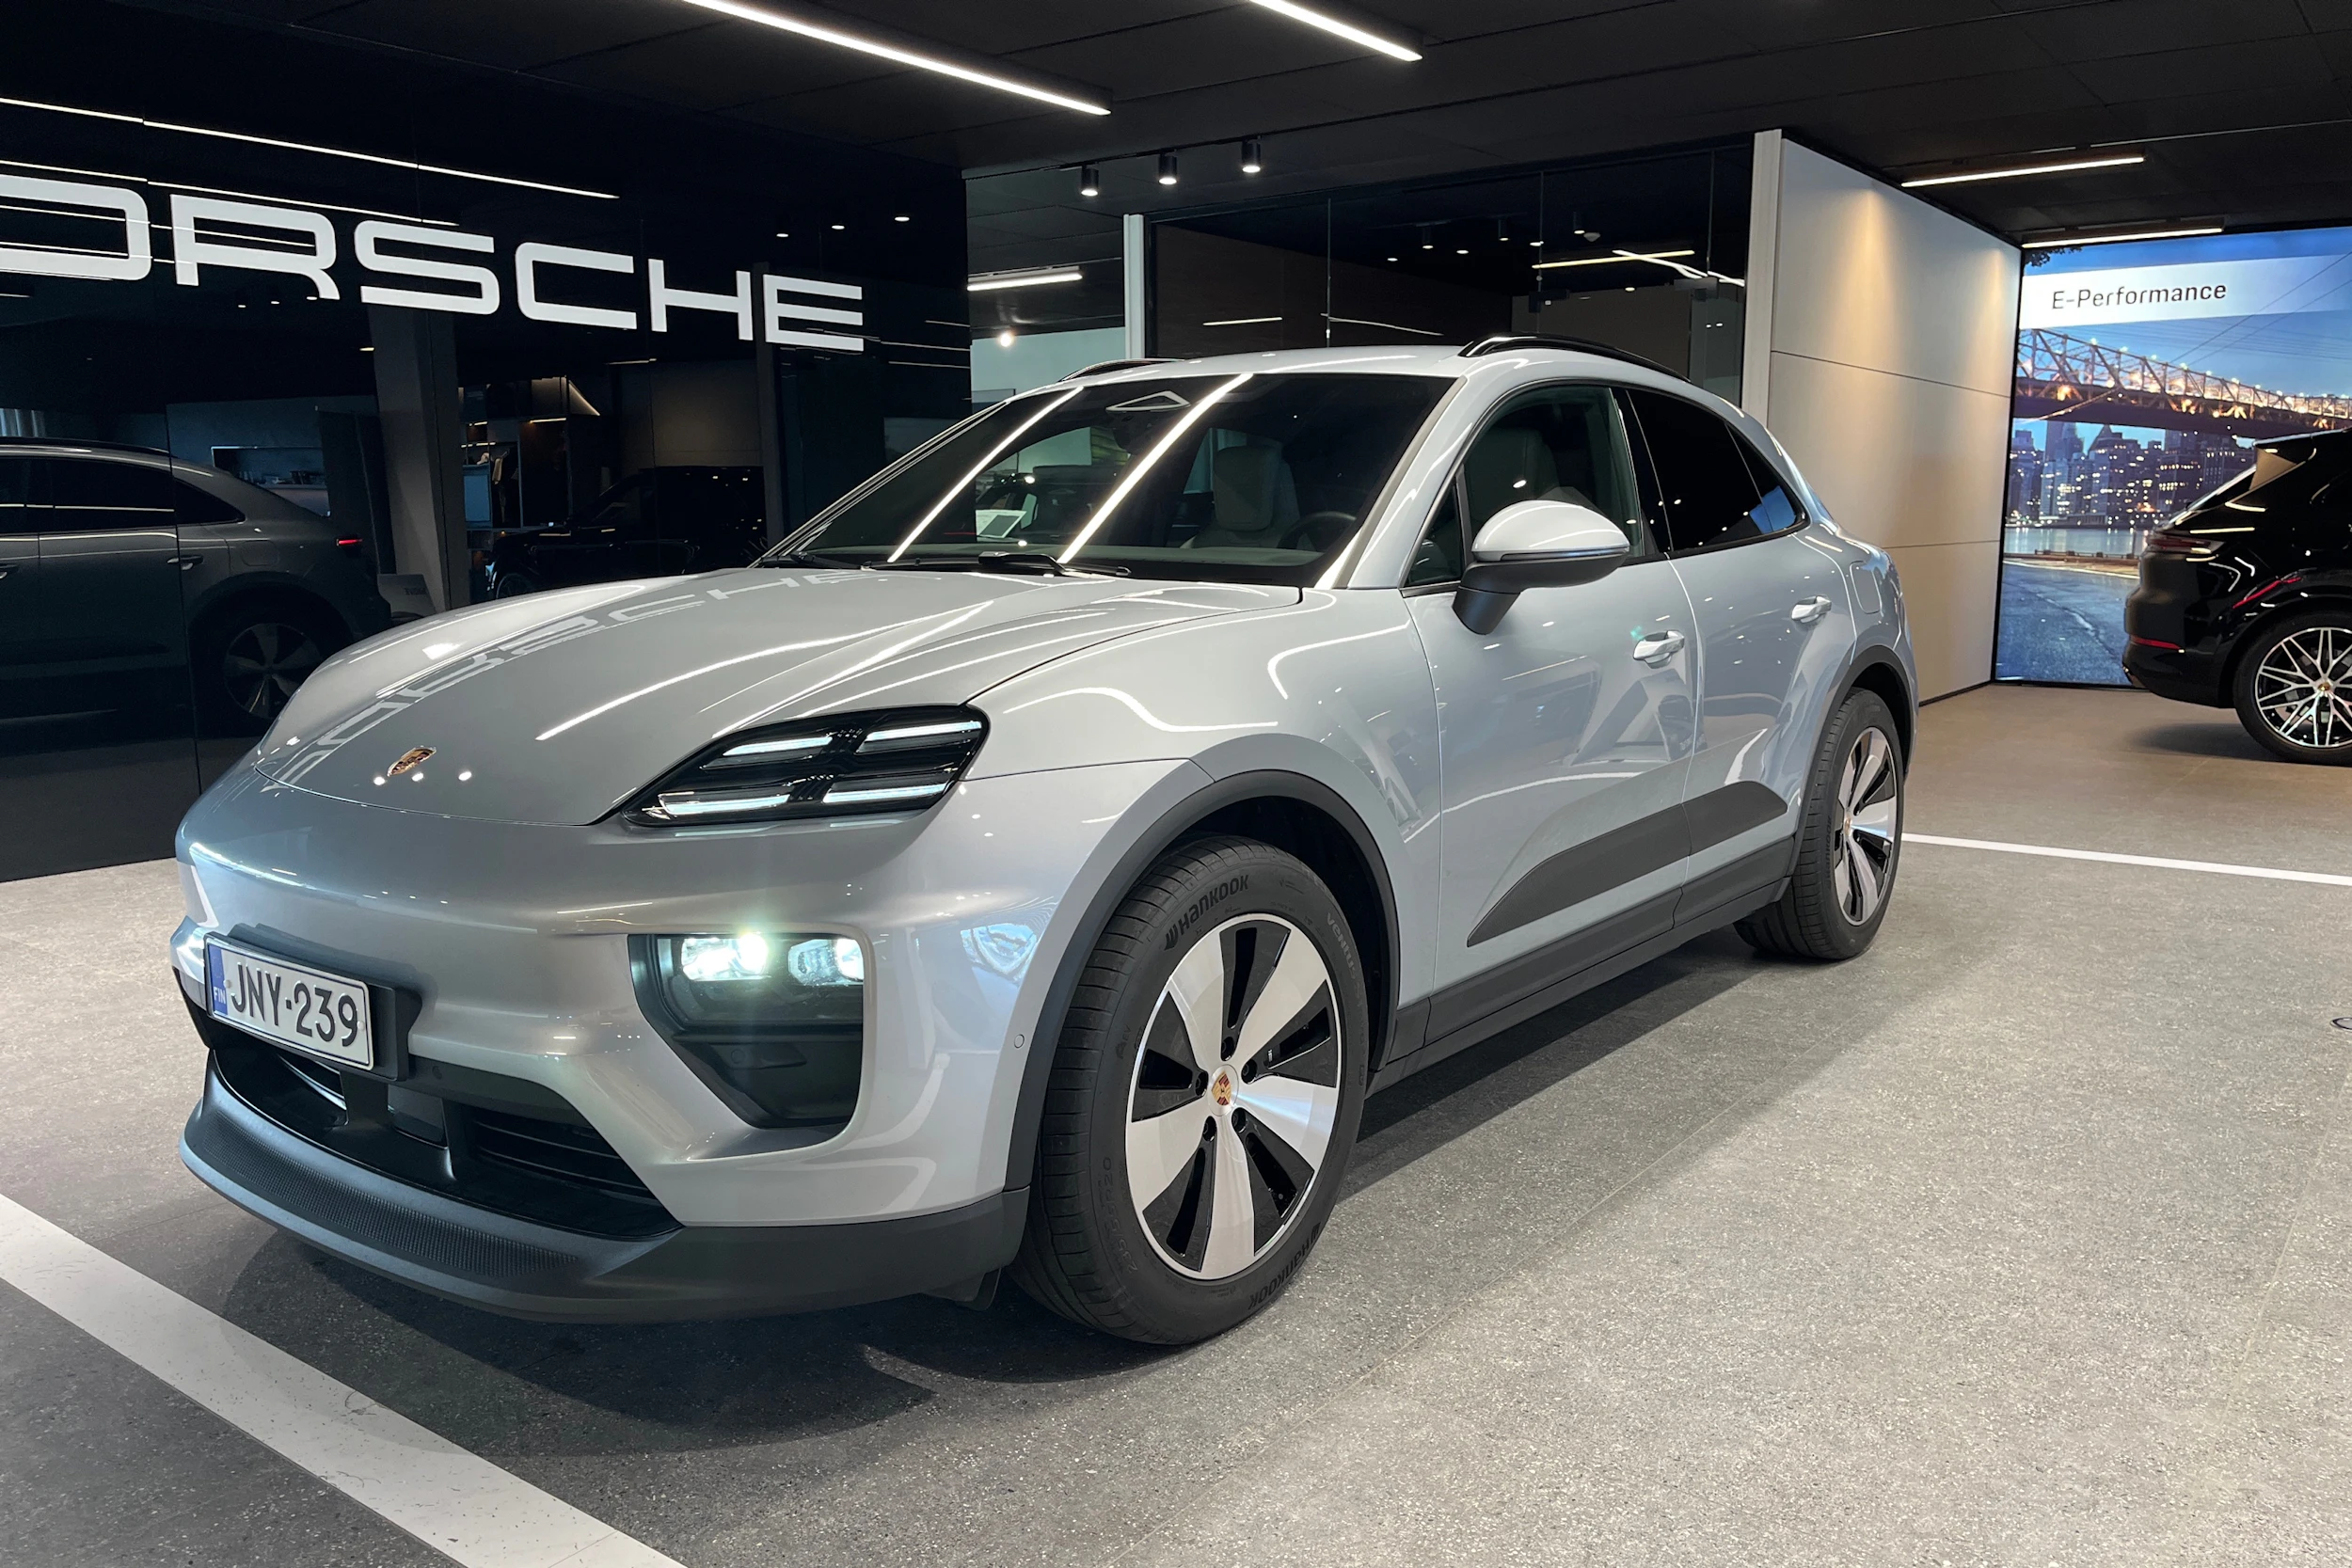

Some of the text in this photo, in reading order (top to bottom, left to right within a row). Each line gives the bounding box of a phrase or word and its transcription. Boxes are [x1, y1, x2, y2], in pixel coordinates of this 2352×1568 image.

[2052, 283, 2227, 309] E-Performance
[214, 985, 226, 1005] FIN
[230, 961, 358, 1048] JNY-239
